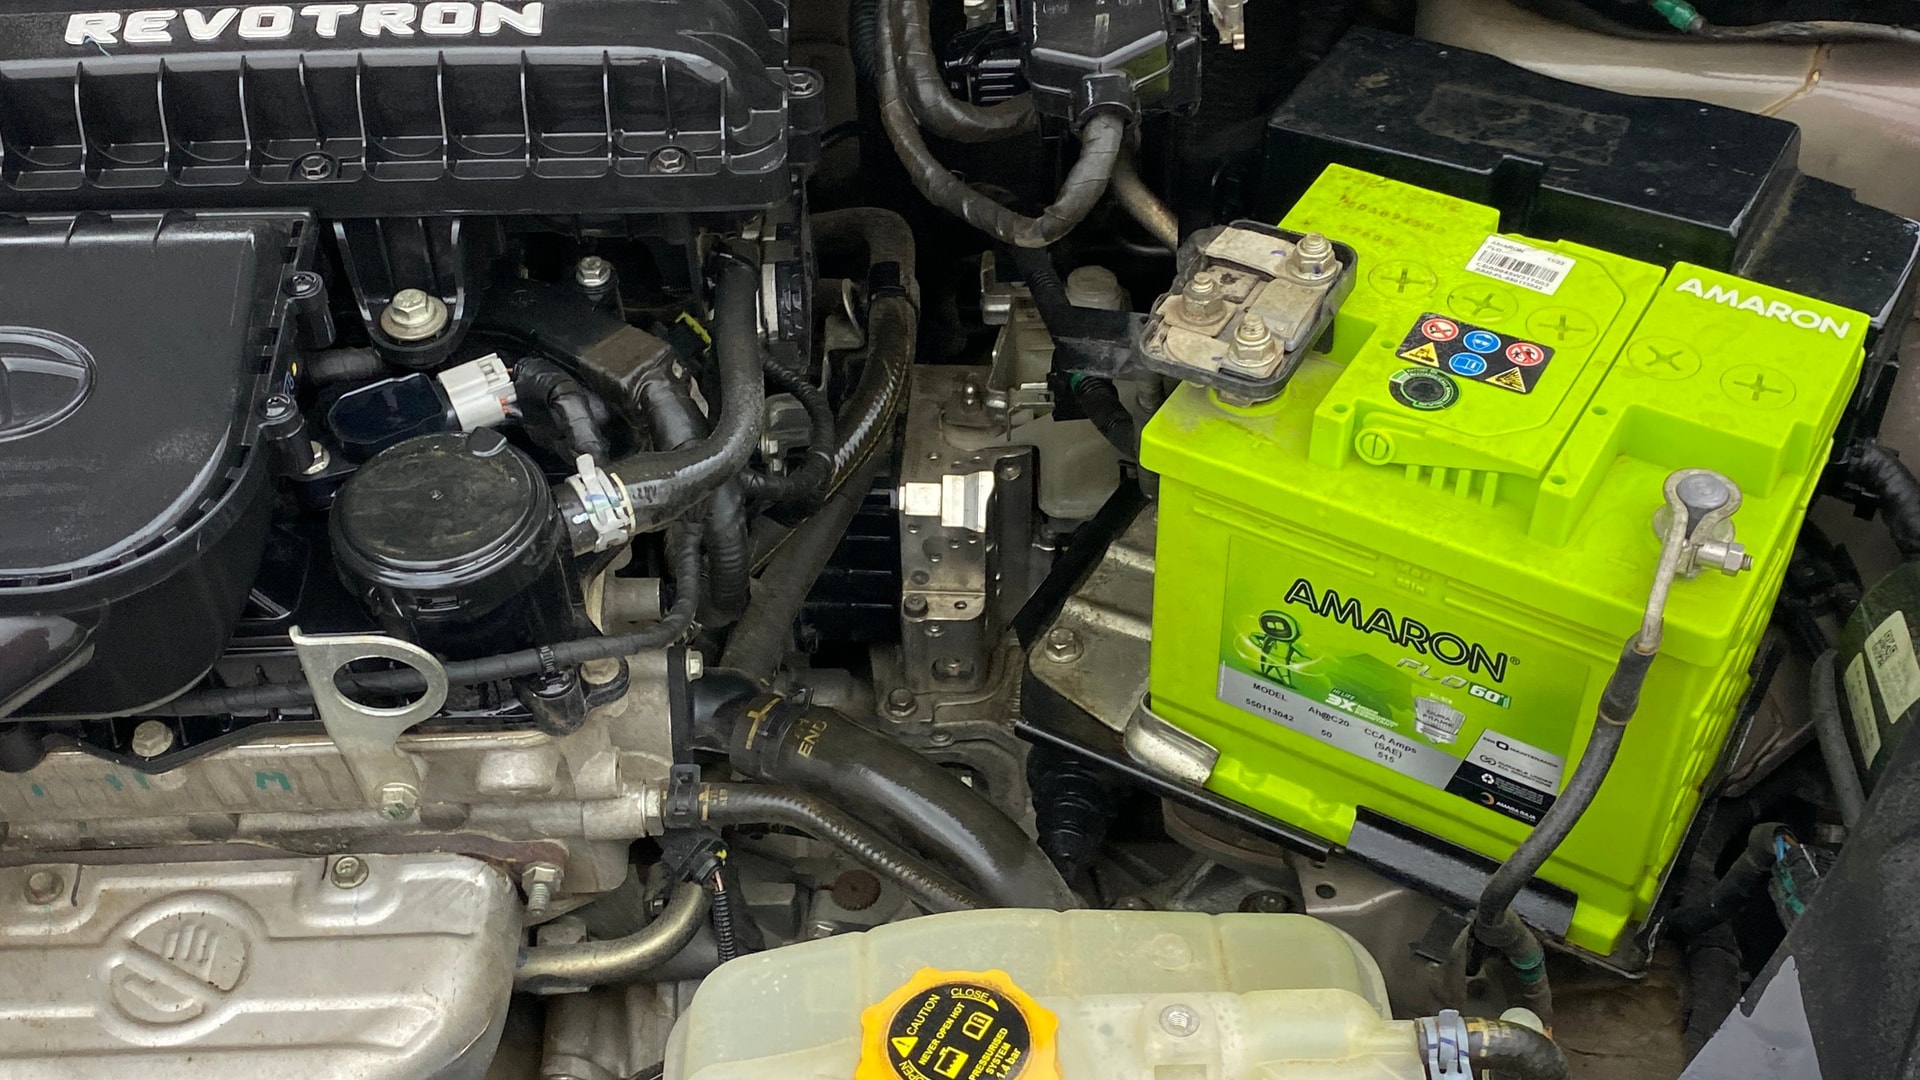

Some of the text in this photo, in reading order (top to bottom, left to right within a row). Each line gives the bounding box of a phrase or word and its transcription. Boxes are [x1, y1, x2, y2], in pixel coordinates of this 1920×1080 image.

[64, 1, 544, 45] REVOTRON
[1676, 278, 1850, 339] AMARON
[1397, 657, 1469, 689] FLO
[1253, 683, 1287, 701] MODEL
[1308, 706, 1350, 728] Ah@C20
[1364, 728, 1386, 741] CCA
[1388, 737, 1417, 754] Amps
[1325, 693, 1358, 712] 3X
[1246, 698, 1395, 763] 550113042 50 515
[1374, 741, 1402, 759] (SAE)
[906, 993, 940, 1036] CAUTION
[950, 987, 990, 1000] CLOSE
[918, 1001, 966, 1066] NEVER OPEN HOT
[968, 1027, 1009, 1080] PRESSURISED
[985, 1042, 1012, 1075] SYSTEM
[996, 1047, 1021, 1080] 1.4 bar
